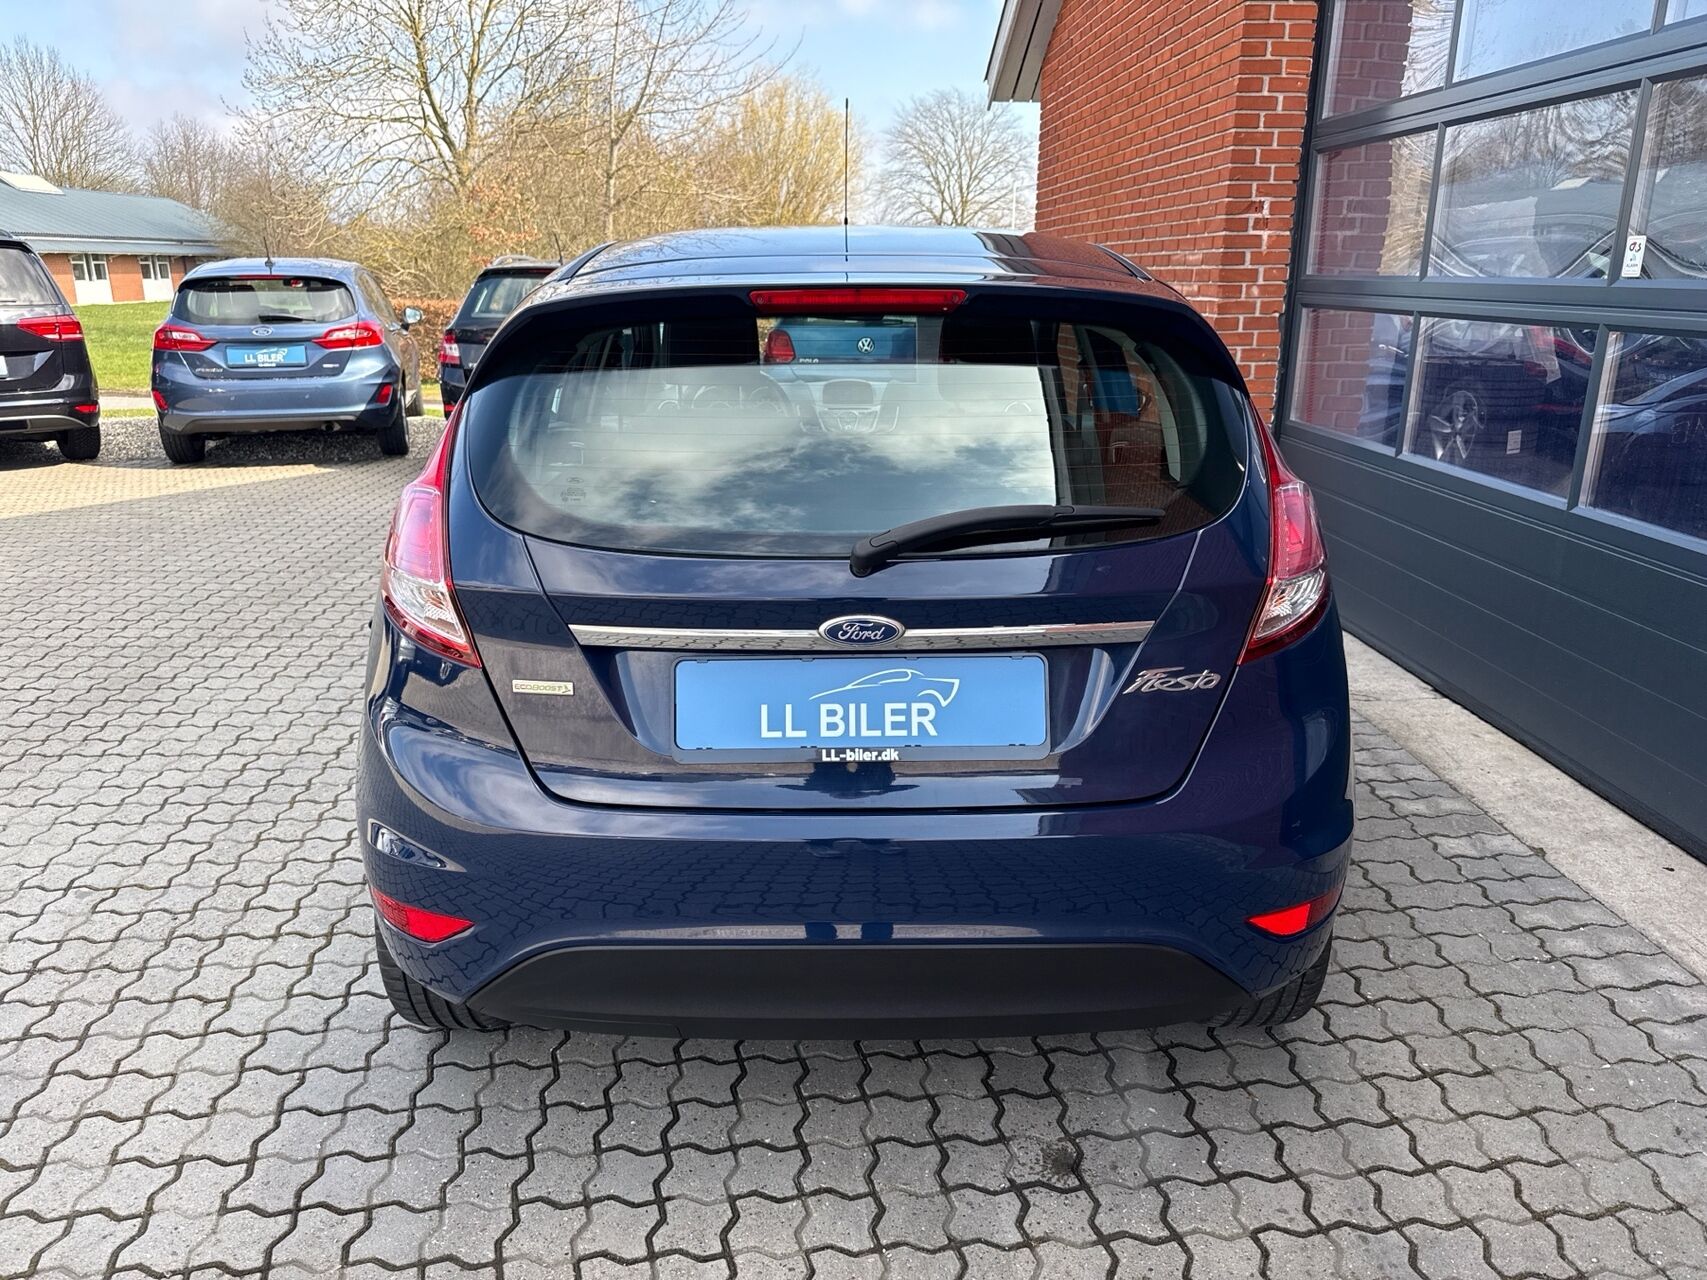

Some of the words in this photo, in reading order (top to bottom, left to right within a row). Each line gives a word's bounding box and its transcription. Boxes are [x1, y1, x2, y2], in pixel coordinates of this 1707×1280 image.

[244, 353, 257, 363] LL
[257, 353, 284, 363] BILER
[838, 622, 885, 640] Ford
[760, 703, 807, 738] LL
[819, 702, 938, 737] BILER
[821, 747, 900, 762] LL-biler.dk
